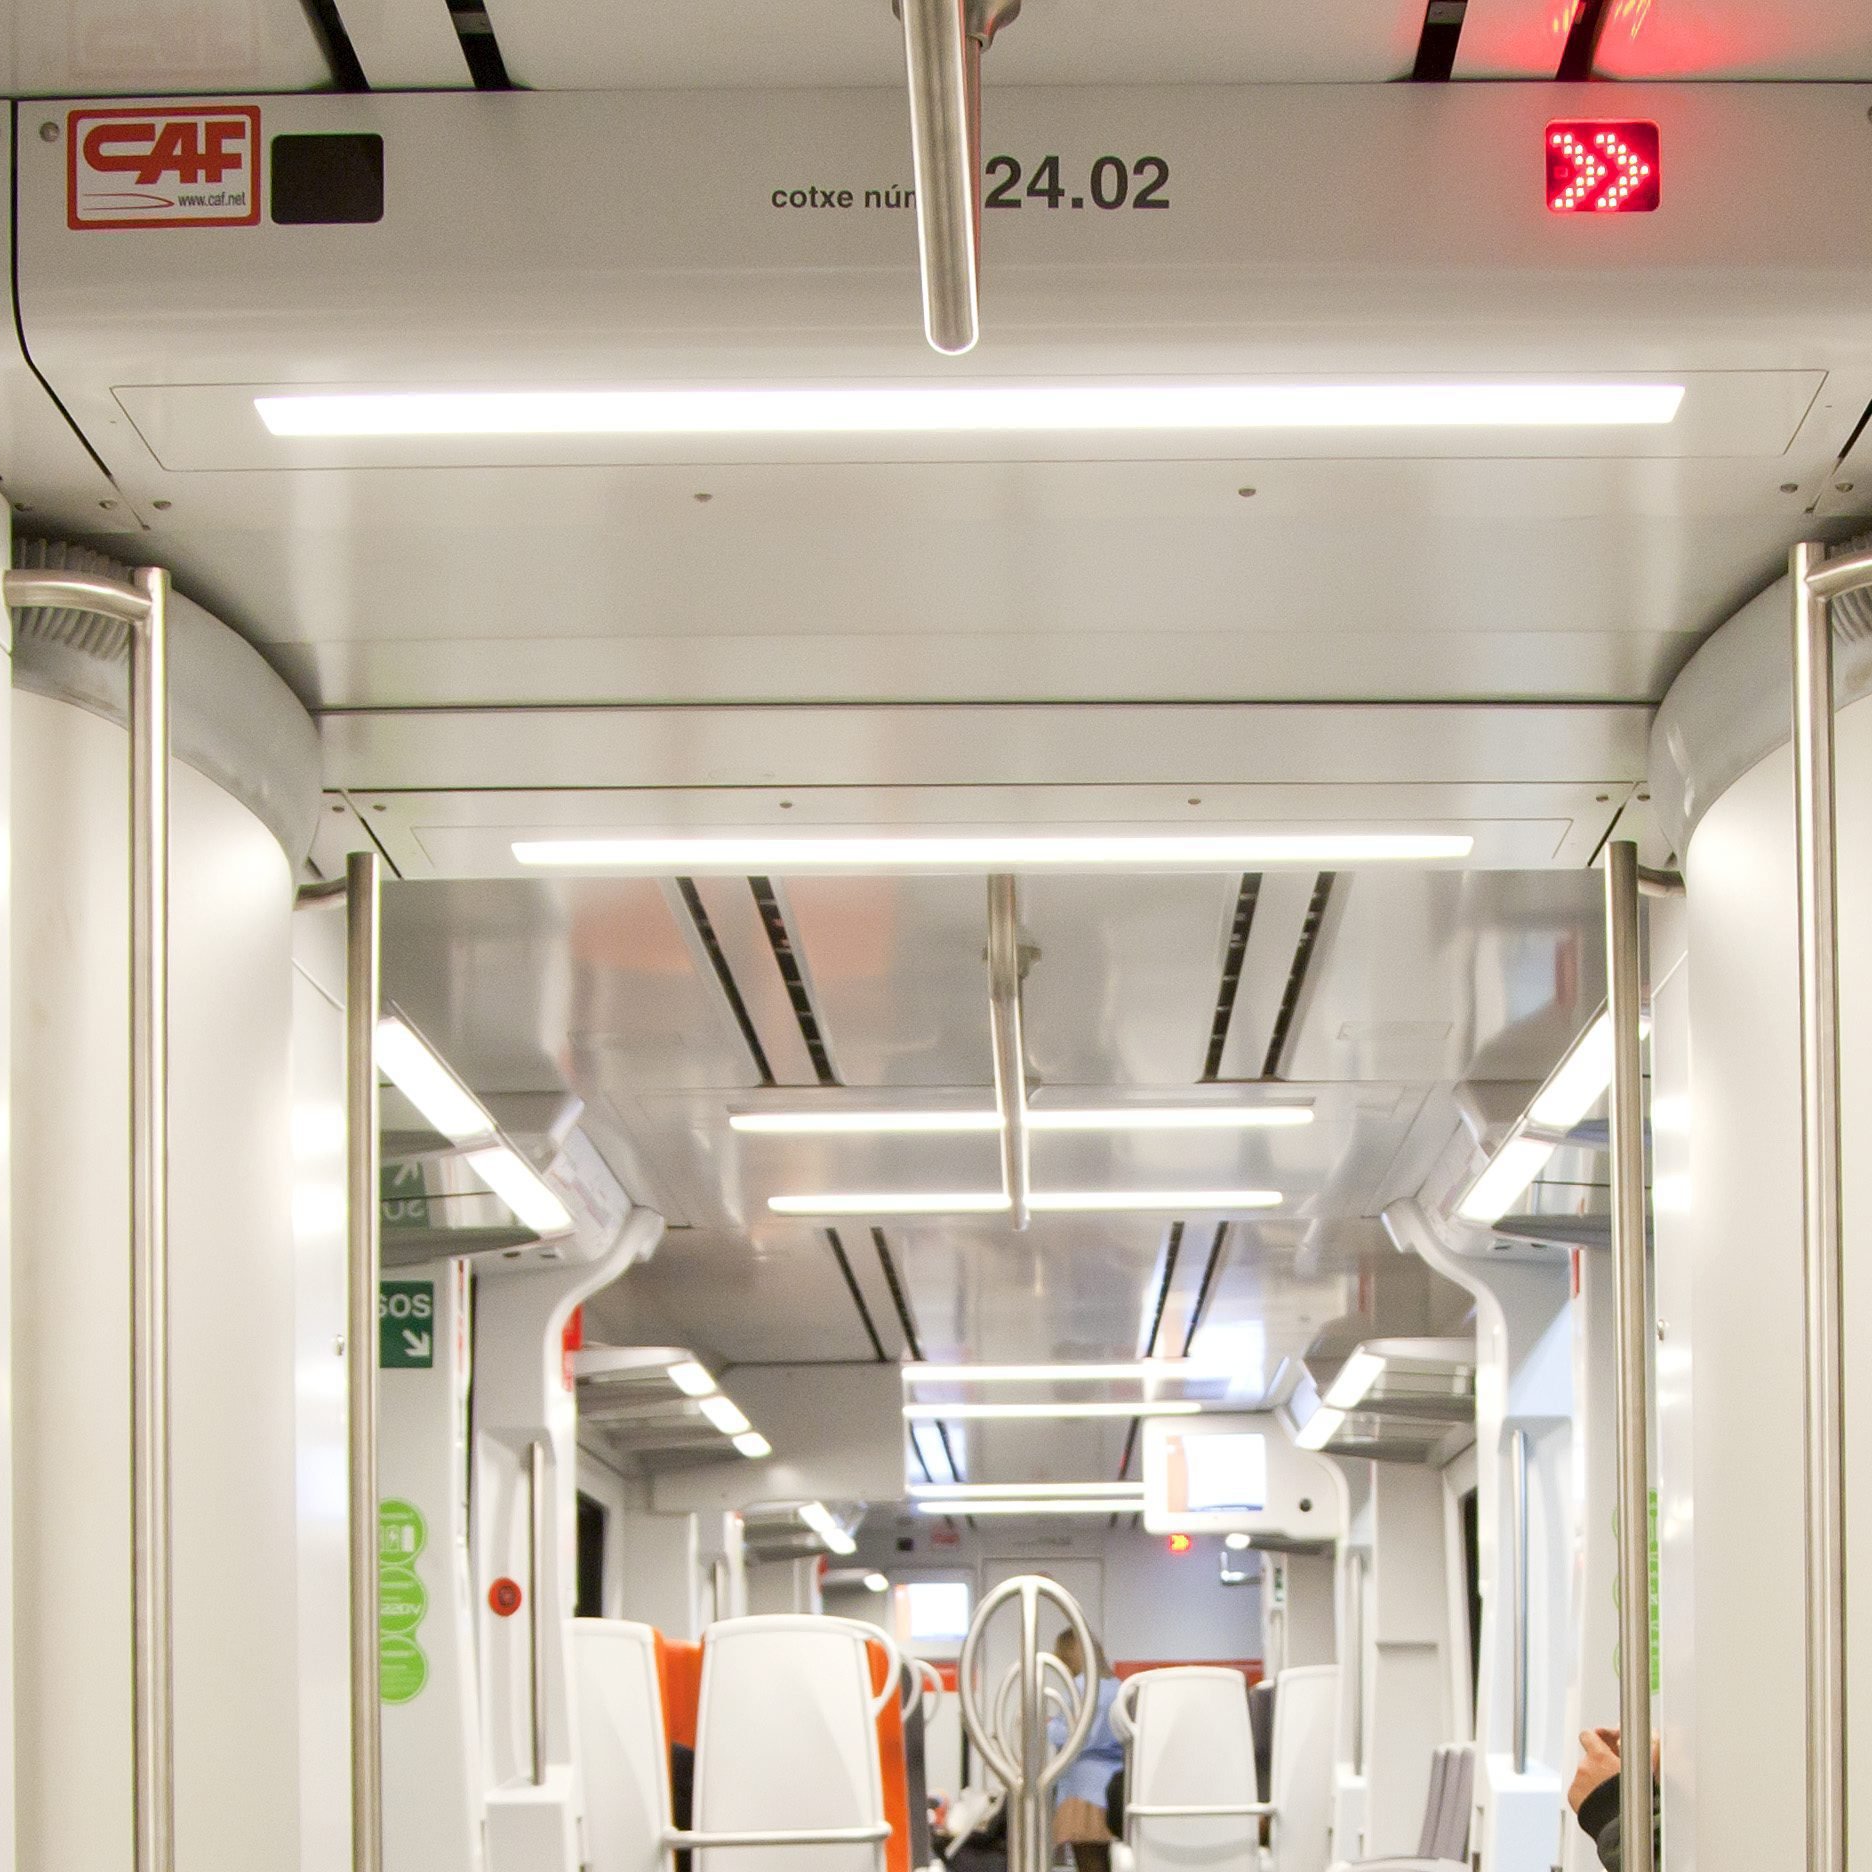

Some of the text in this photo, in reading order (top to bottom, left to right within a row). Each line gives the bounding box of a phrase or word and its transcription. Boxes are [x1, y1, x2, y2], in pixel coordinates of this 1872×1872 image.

[82, 121, 247, 185] CAF
[177, 191, 247, 208] www.caf.net
[770, 186, 854, 210] cotxe
[983, 154, 1171, 210] 24.02
